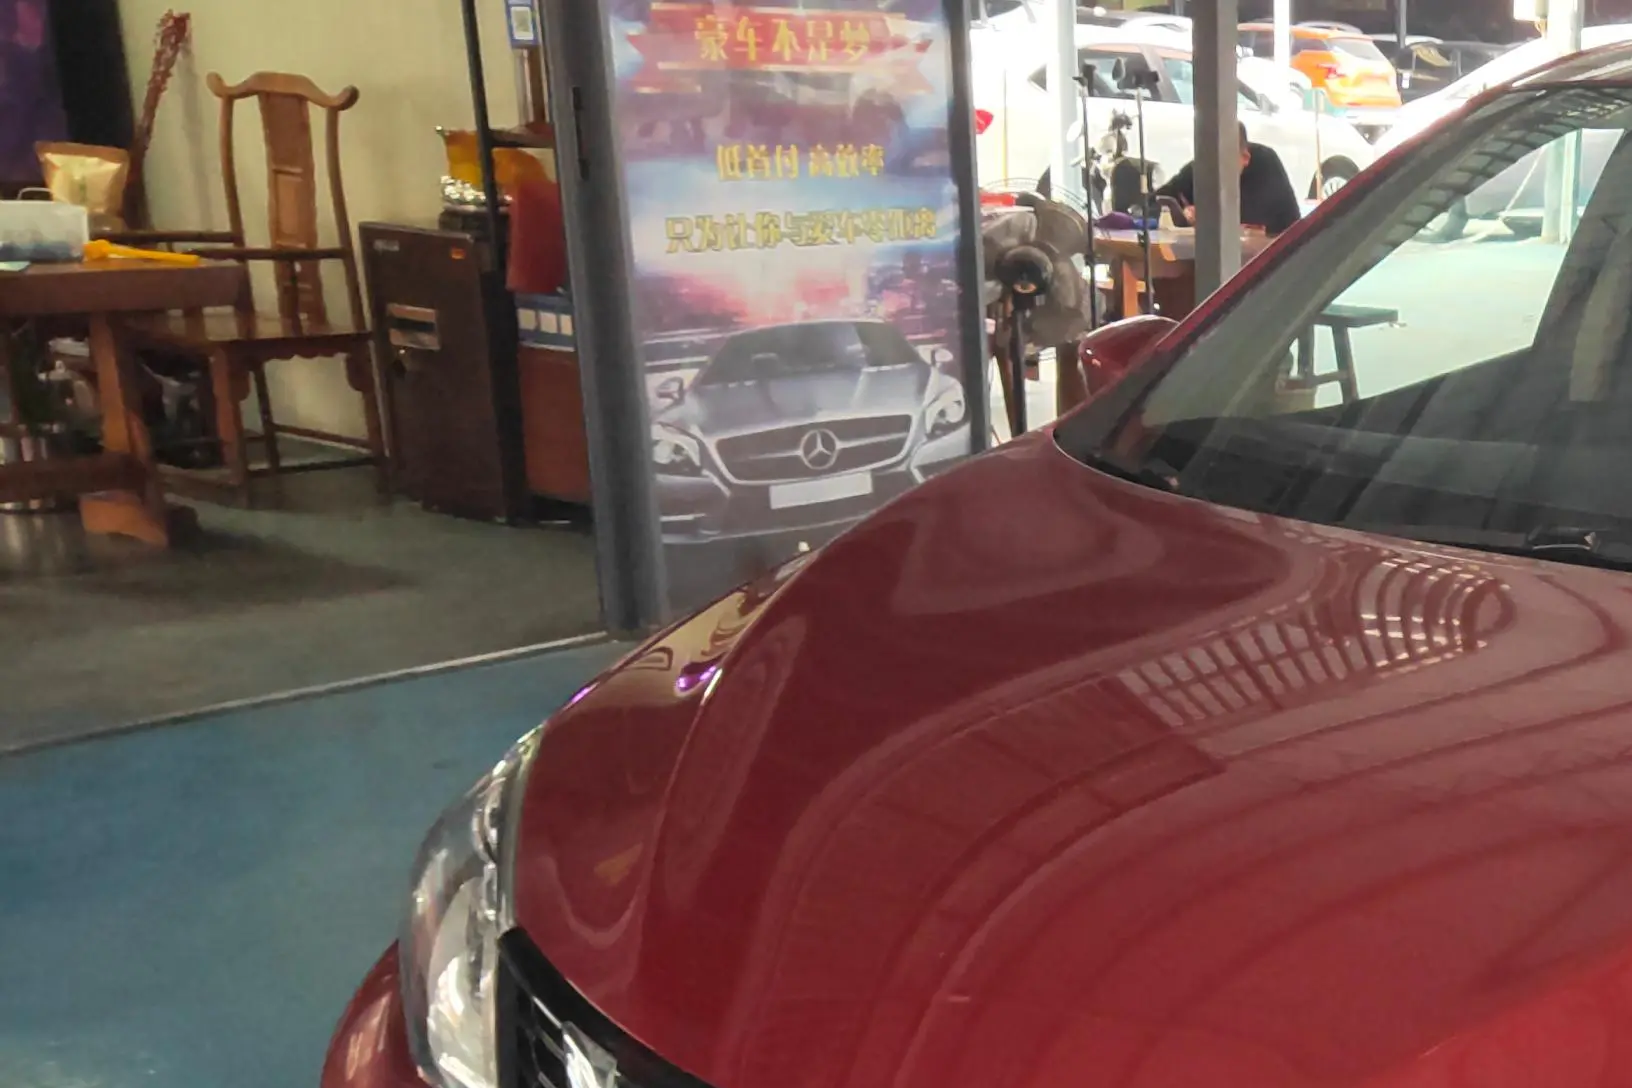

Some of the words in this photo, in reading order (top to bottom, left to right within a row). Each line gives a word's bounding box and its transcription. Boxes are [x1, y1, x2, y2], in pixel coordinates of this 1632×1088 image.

[694, 14, 871, 63] 豪车不是梦
